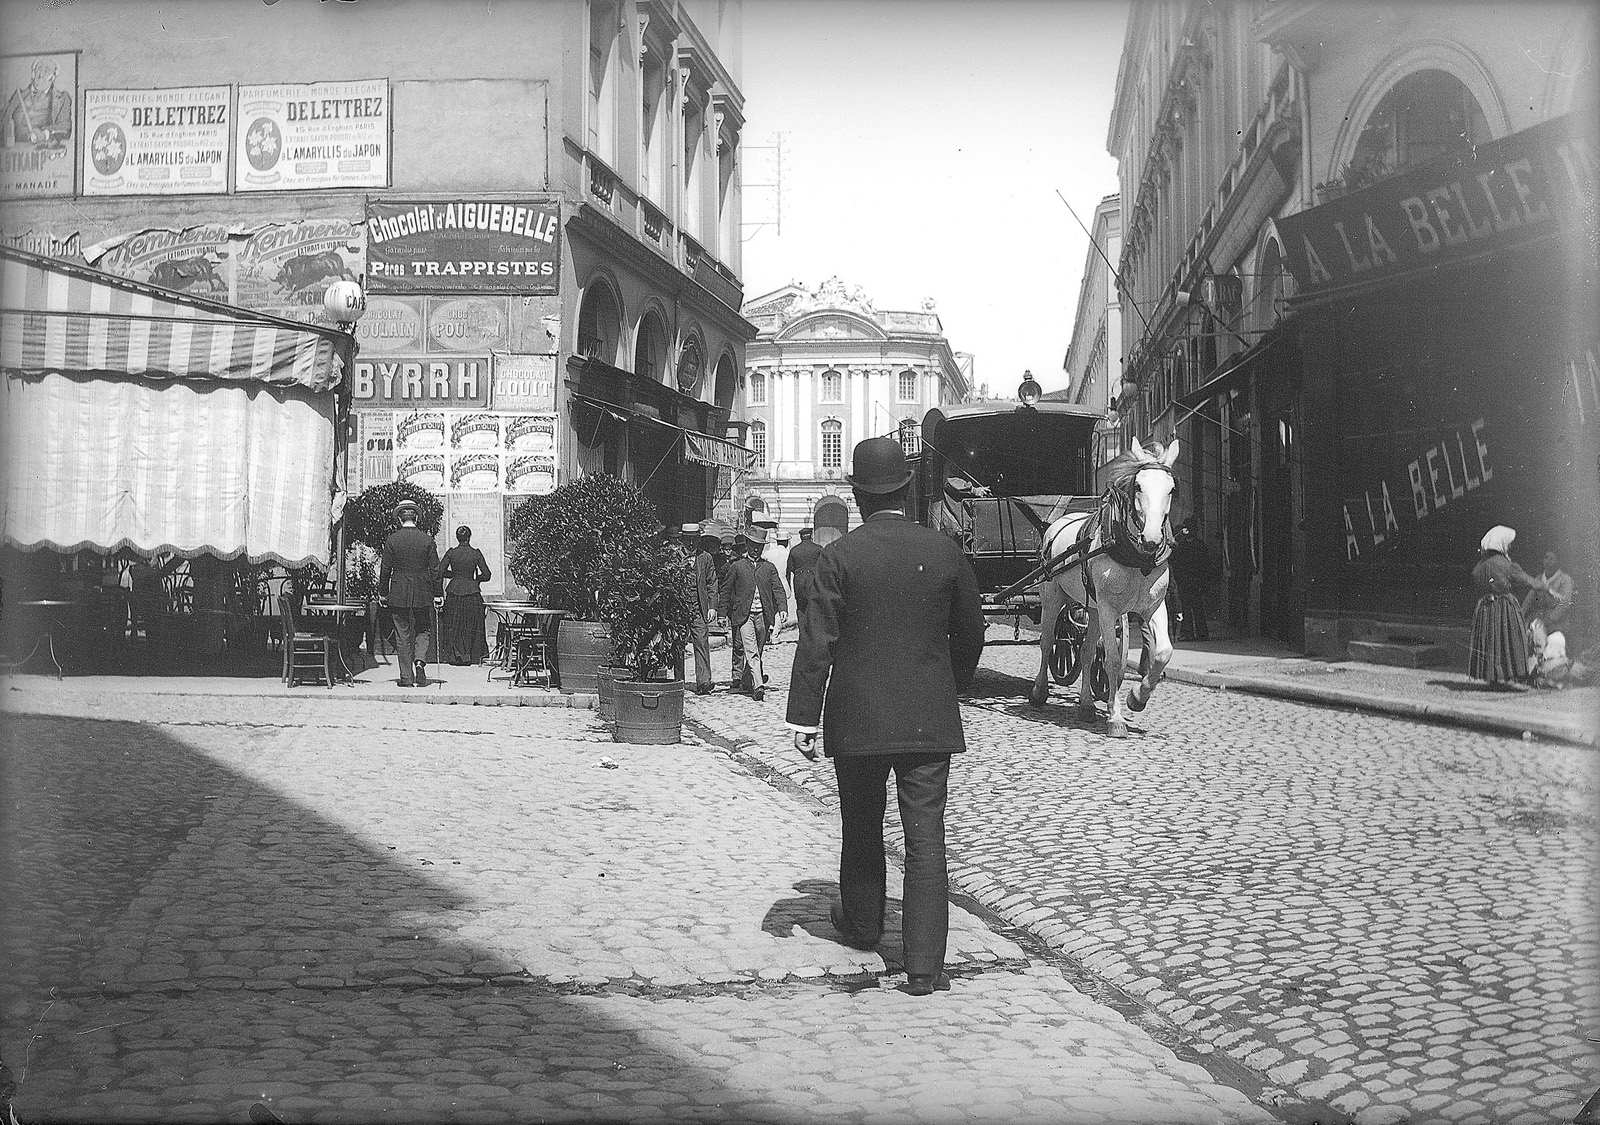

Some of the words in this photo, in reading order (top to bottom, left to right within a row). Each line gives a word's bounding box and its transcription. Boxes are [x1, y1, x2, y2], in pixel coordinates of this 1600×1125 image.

[156, 91, 185, 102] MONDE
[131, 104, 226, 127] DELETTREZ
[286, 97, 382, 121] DELETTREZ
[130, 151, 184, 166] L'AMARYLLIS
[195, 150, 222, 164] JAPON
[287, 145, 342, 160] L'AMARYLLIS
[353, 143, 381, 157] JAPON
[369, 204, 435, 244] Chocolat
[436, 203, 558, 244] d'AIGUEBELLE
[1301, 230, 1333, 284] A
[1333, 212, 1398, 272] LA
[1399, 156, 1551, 252] BELLE
[168, 249, 190, 261] EXTRAIT
[298, 244, 320, 256] EXTRAIT
[411, 261, 554, 276] TRAPPISTES
[358, 321, 416, 338] OULAIN
[354, 362, 479, 400] BYRRH
[496, 379, 551, 397] LOUIT
[1342, 504, 1361, 561] A
[1365, 480, 1399, 546] LA
[1406, 417, 1495, 521] BELLE
